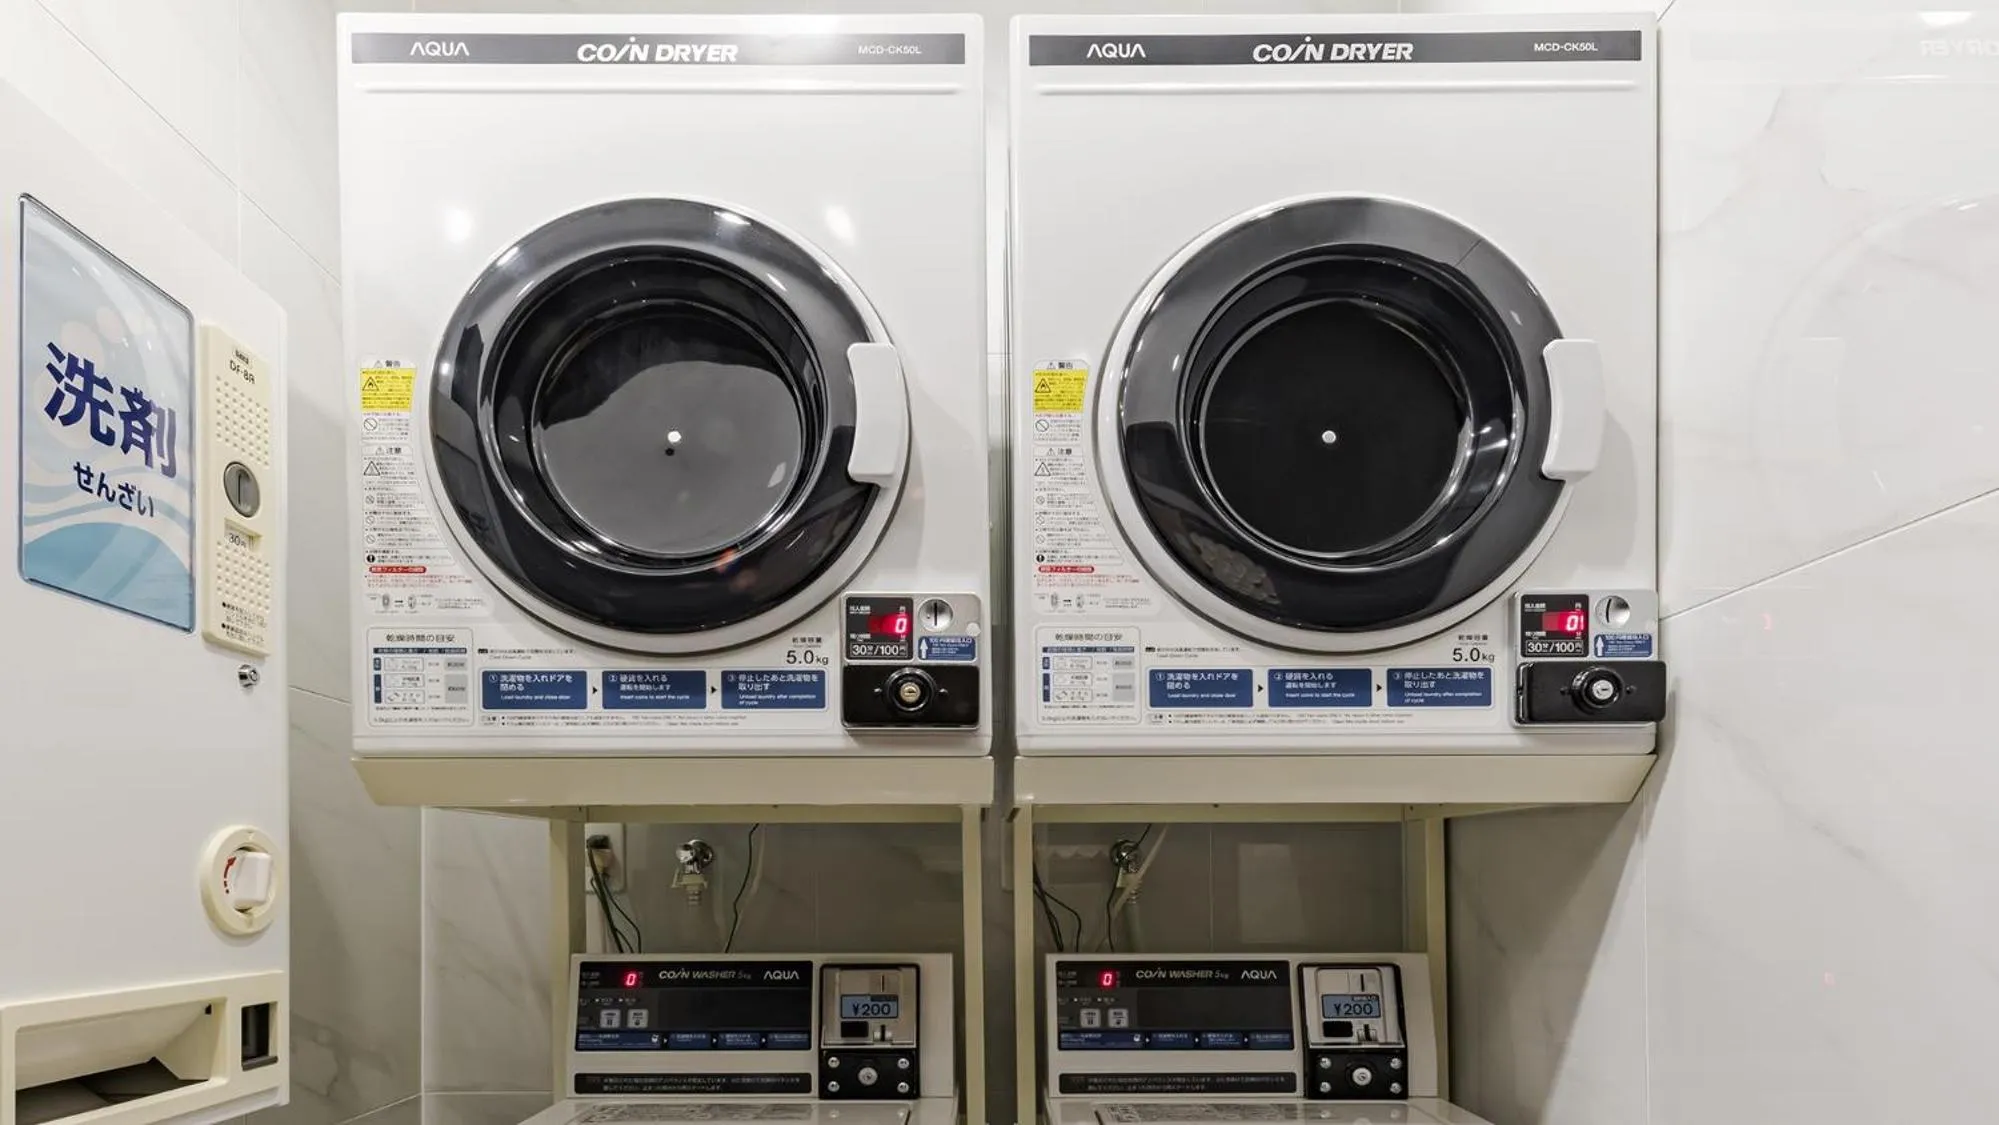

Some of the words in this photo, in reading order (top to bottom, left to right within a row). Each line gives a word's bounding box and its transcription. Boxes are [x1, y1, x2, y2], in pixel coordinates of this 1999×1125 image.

[410, 42, 470, 57] AQUA
[655, 43, 739, 62] DRYER
[858, 45, 922, 55] MCD-CK50L
[1086, 44, 1146, 59] AQUA
[1330, 42, 1414, 61] DRYER
[1534, 42, 1598, 53] MCD-CK50L
[43, 341, 177, 479] 洗剤
[73, 461, 155, 519] せんざい
[895, 617, 907, 633] 0
[500, 674, 573, 682] 洗濯物を入れドアを
[738, 674, 818, 682] 停止したあと洗濯物を
[1404, 672, 1484, 680] 停止したあと洗濯物を
[738, 683, 770, 691] 取り出す
[625, 973, 637, 986] 0
[692, 971, 736, 979] WASHER
[763, 970, 800, 981] AQUA
[1103, 973, 1113, 986] 0
[1169, 970, 1213, 979] WASHER
[1241, 970, 1277, 980] AQUA
[852, 1003, 891, 1016] ¥200
